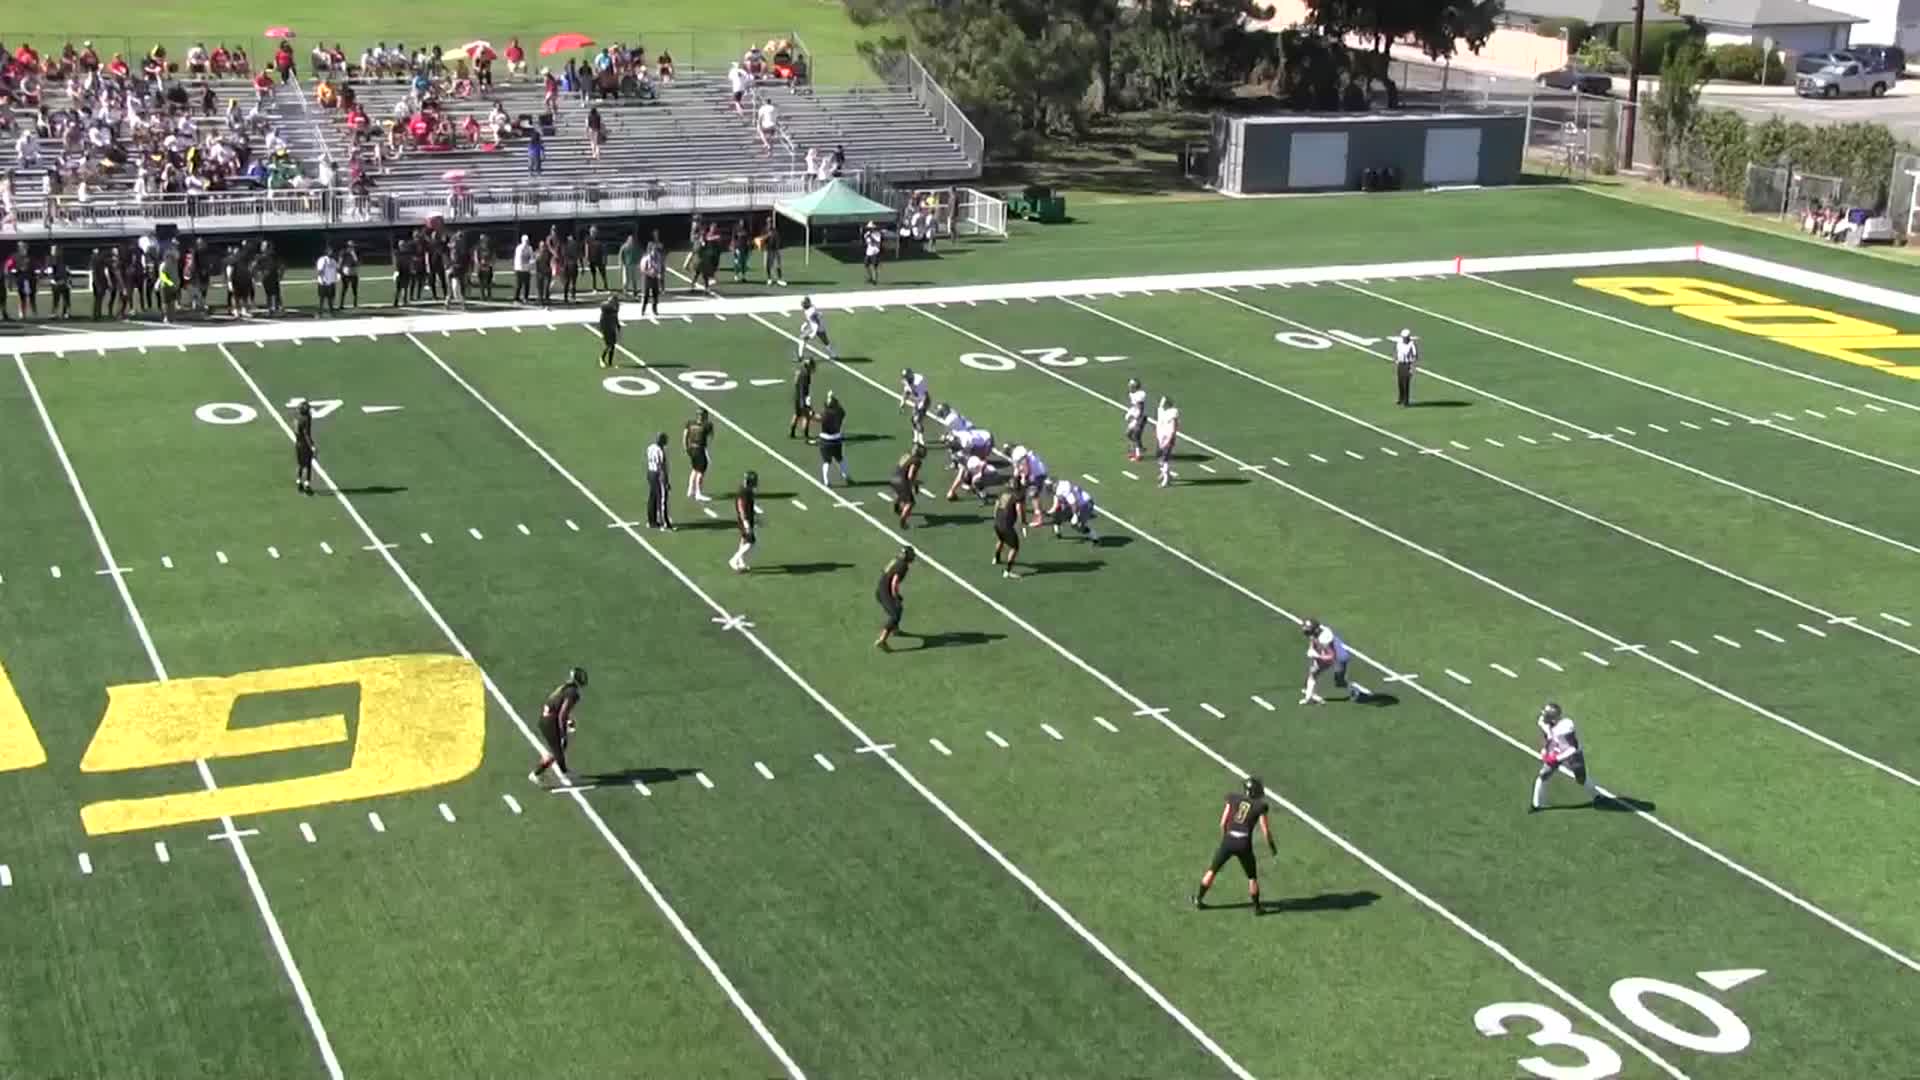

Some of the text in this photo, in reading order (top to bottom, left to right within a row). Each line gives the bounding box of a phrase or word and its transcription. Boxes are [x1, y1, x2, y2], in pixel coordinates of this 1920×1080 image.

[1274, 328, 1383, 350] 10
[959, 347, 1089, 372] 20
[602, 370, 739, 397] 30
[194, 397, 345, 425] 40
[1473, 976, 1752, 1080] 30
